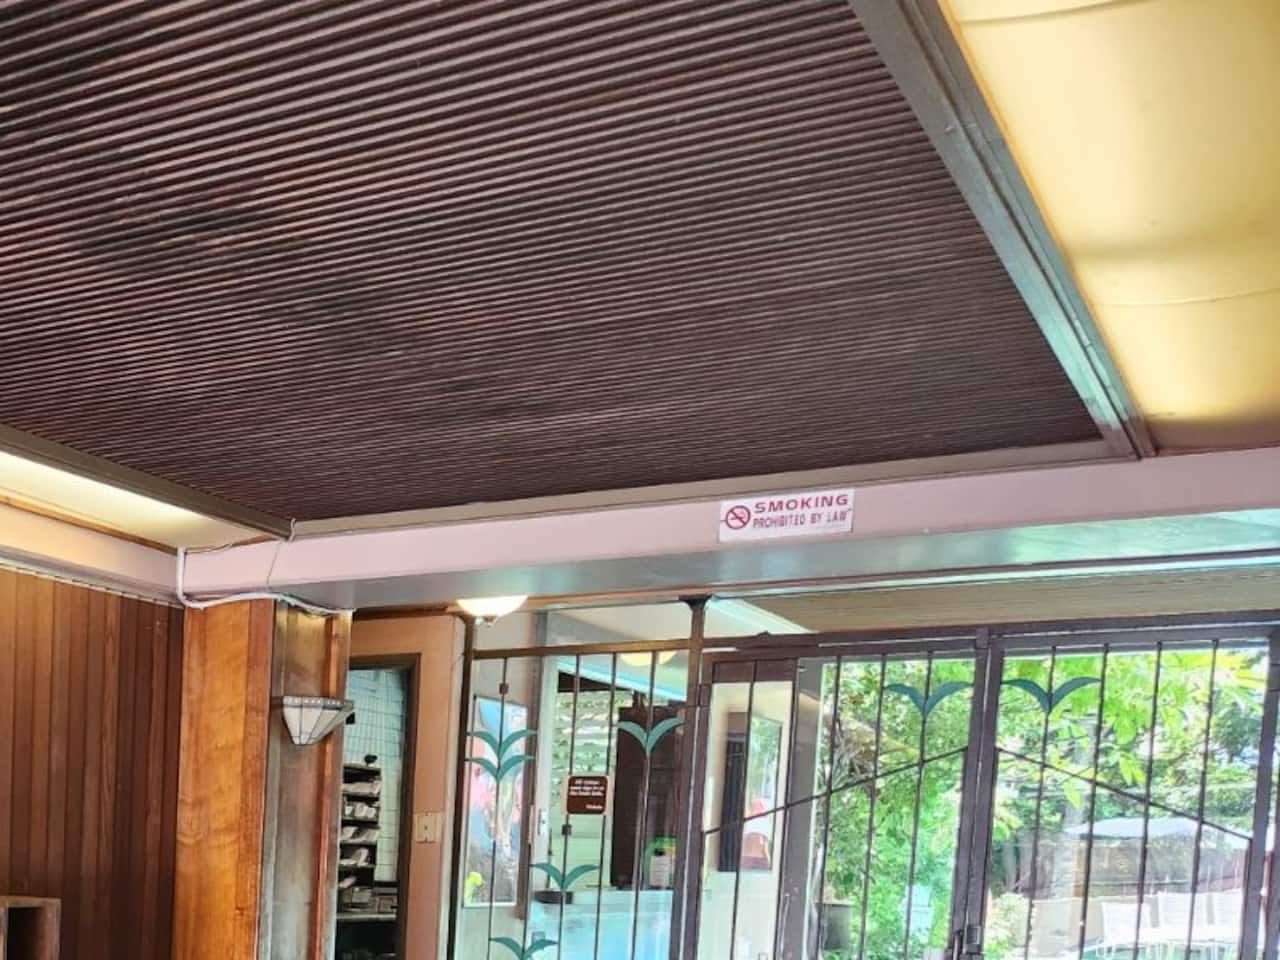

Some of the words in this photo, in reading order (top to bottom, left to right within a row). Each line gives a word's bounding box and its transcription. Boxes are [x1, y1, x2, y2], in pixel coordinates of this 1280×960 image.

[754, 494, 849, 514] SMOKING
[753, 514, 806, 529] PROHIBITED
[810, 512, 822, 525] BY
[826, 510, 847, 523] LAW
